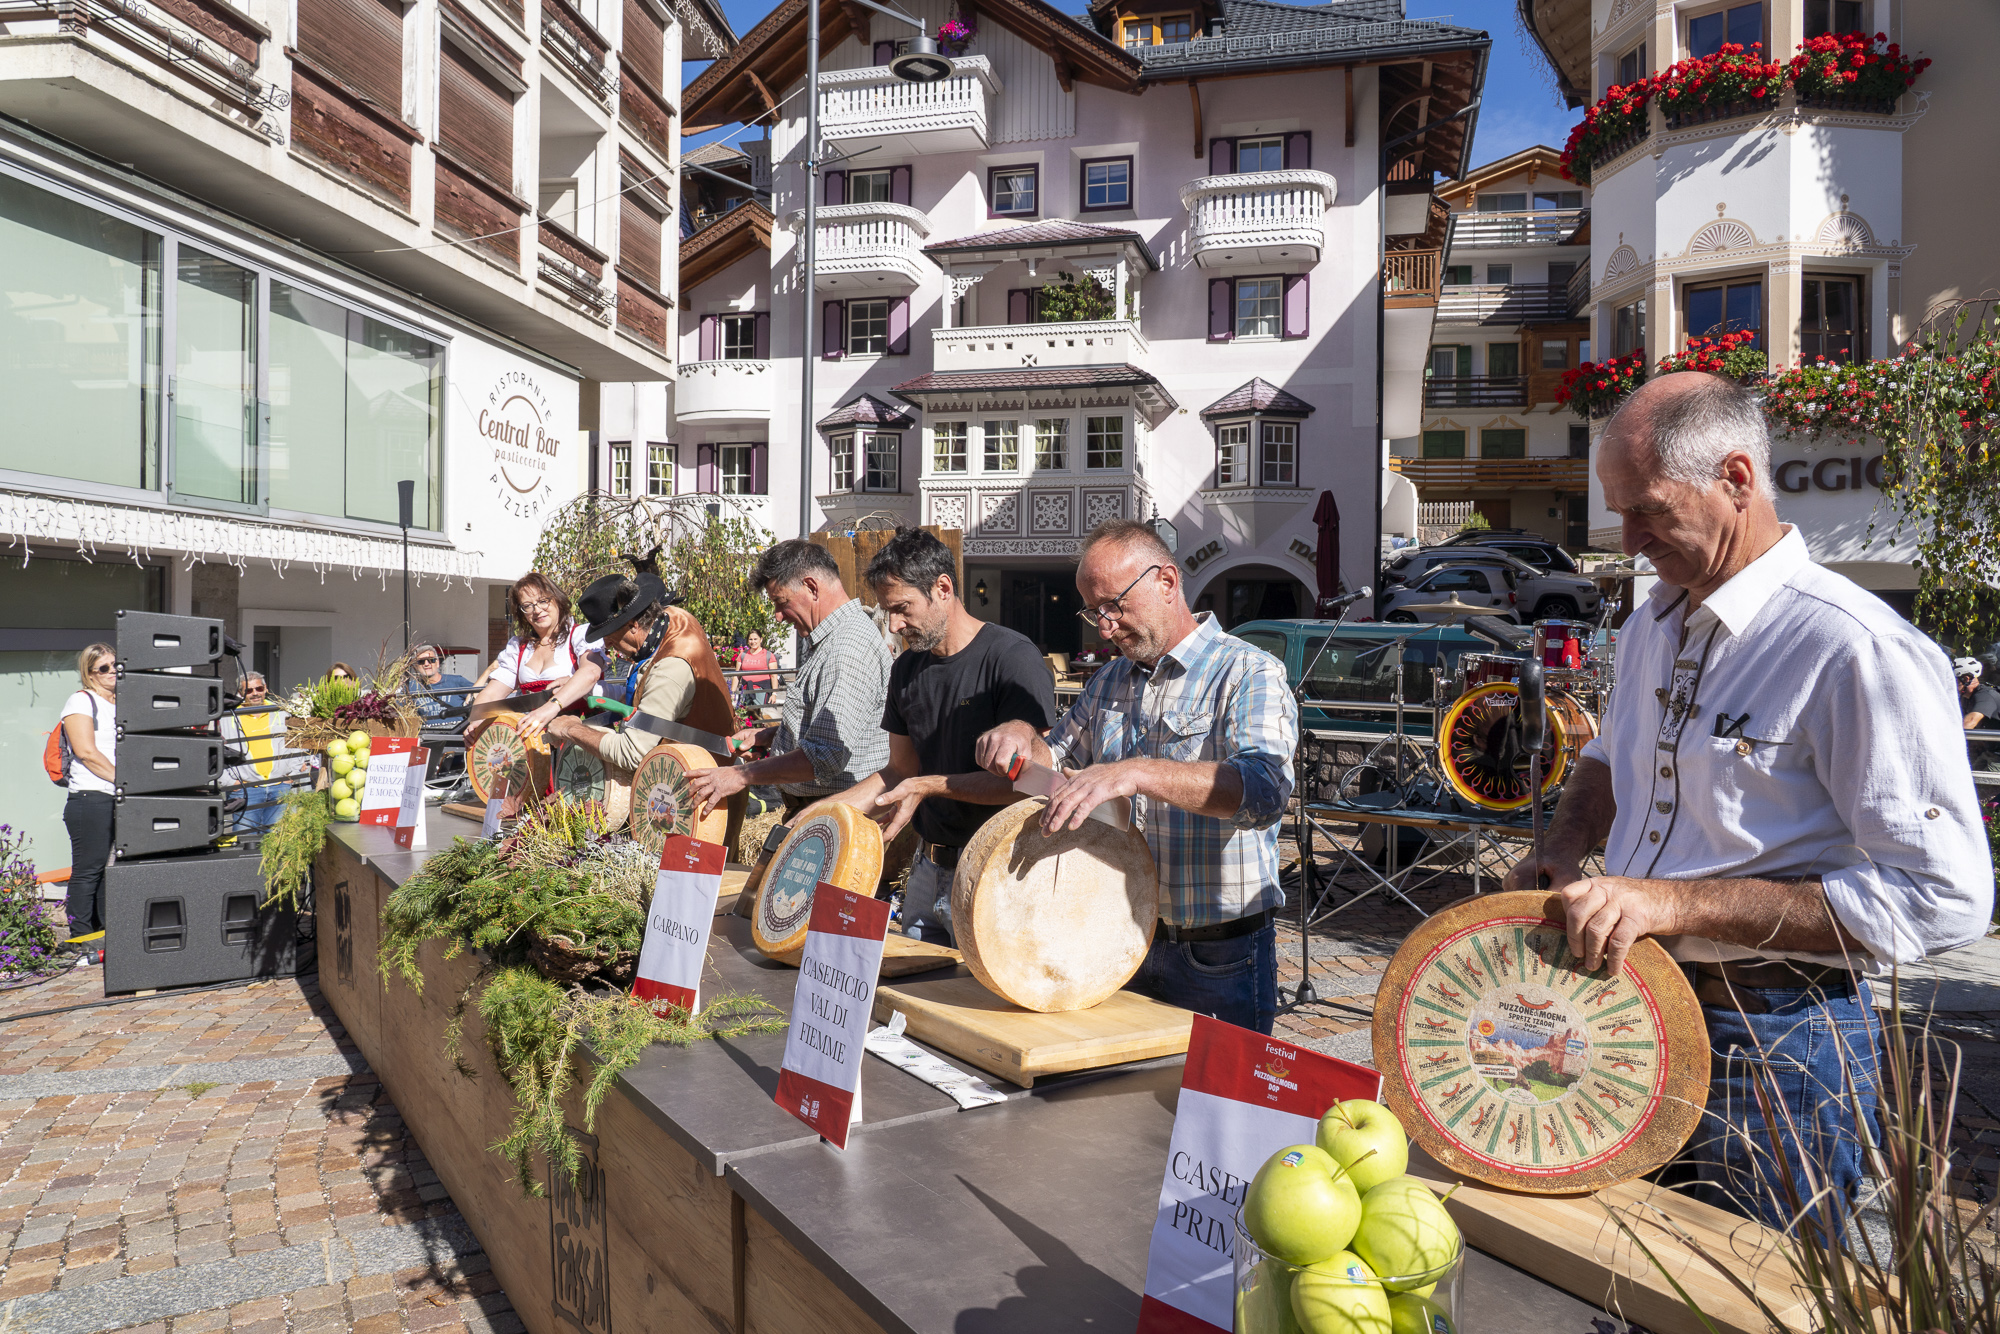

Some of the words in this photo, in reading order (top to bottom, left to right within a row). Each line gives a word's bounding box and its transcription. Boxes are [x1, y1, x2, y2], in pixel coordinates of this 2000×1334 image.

[489, 371, 552, 420] RISTORANTE
[479, 409, 530, 449] Central
[536, 427, 560, 457] Bar
[495, 449, 546, 470] pasticceria
[1775, 454, 1905, 493] GGIO
[490, 474, 552, 518] PIZZERIA
[653, 914, 699, 946] CARPANO
[803, 956, 869, 1002] CASEIFICIO
[810, 992, 831, 1020] VAL
[833, 1003, 848, 1029] DI
[1499, 1002, 1533, 1016] PUZZONE
[1539, 1011, 1566, 1023] MOENA
[800, 1021, 846, 1064] FIEMME
[1266, 1043, 1296, 1060] Festival
[1254, 1070, 1276, 1083] PUZZONE
[1279, 1079, 1297, 1091] MOENA
[1268, 1083, 1280, 1092] DOP
[1172, 1151, 1252, 1207] CASEI
[1170, 1199, 1236, 1259] PRIM
